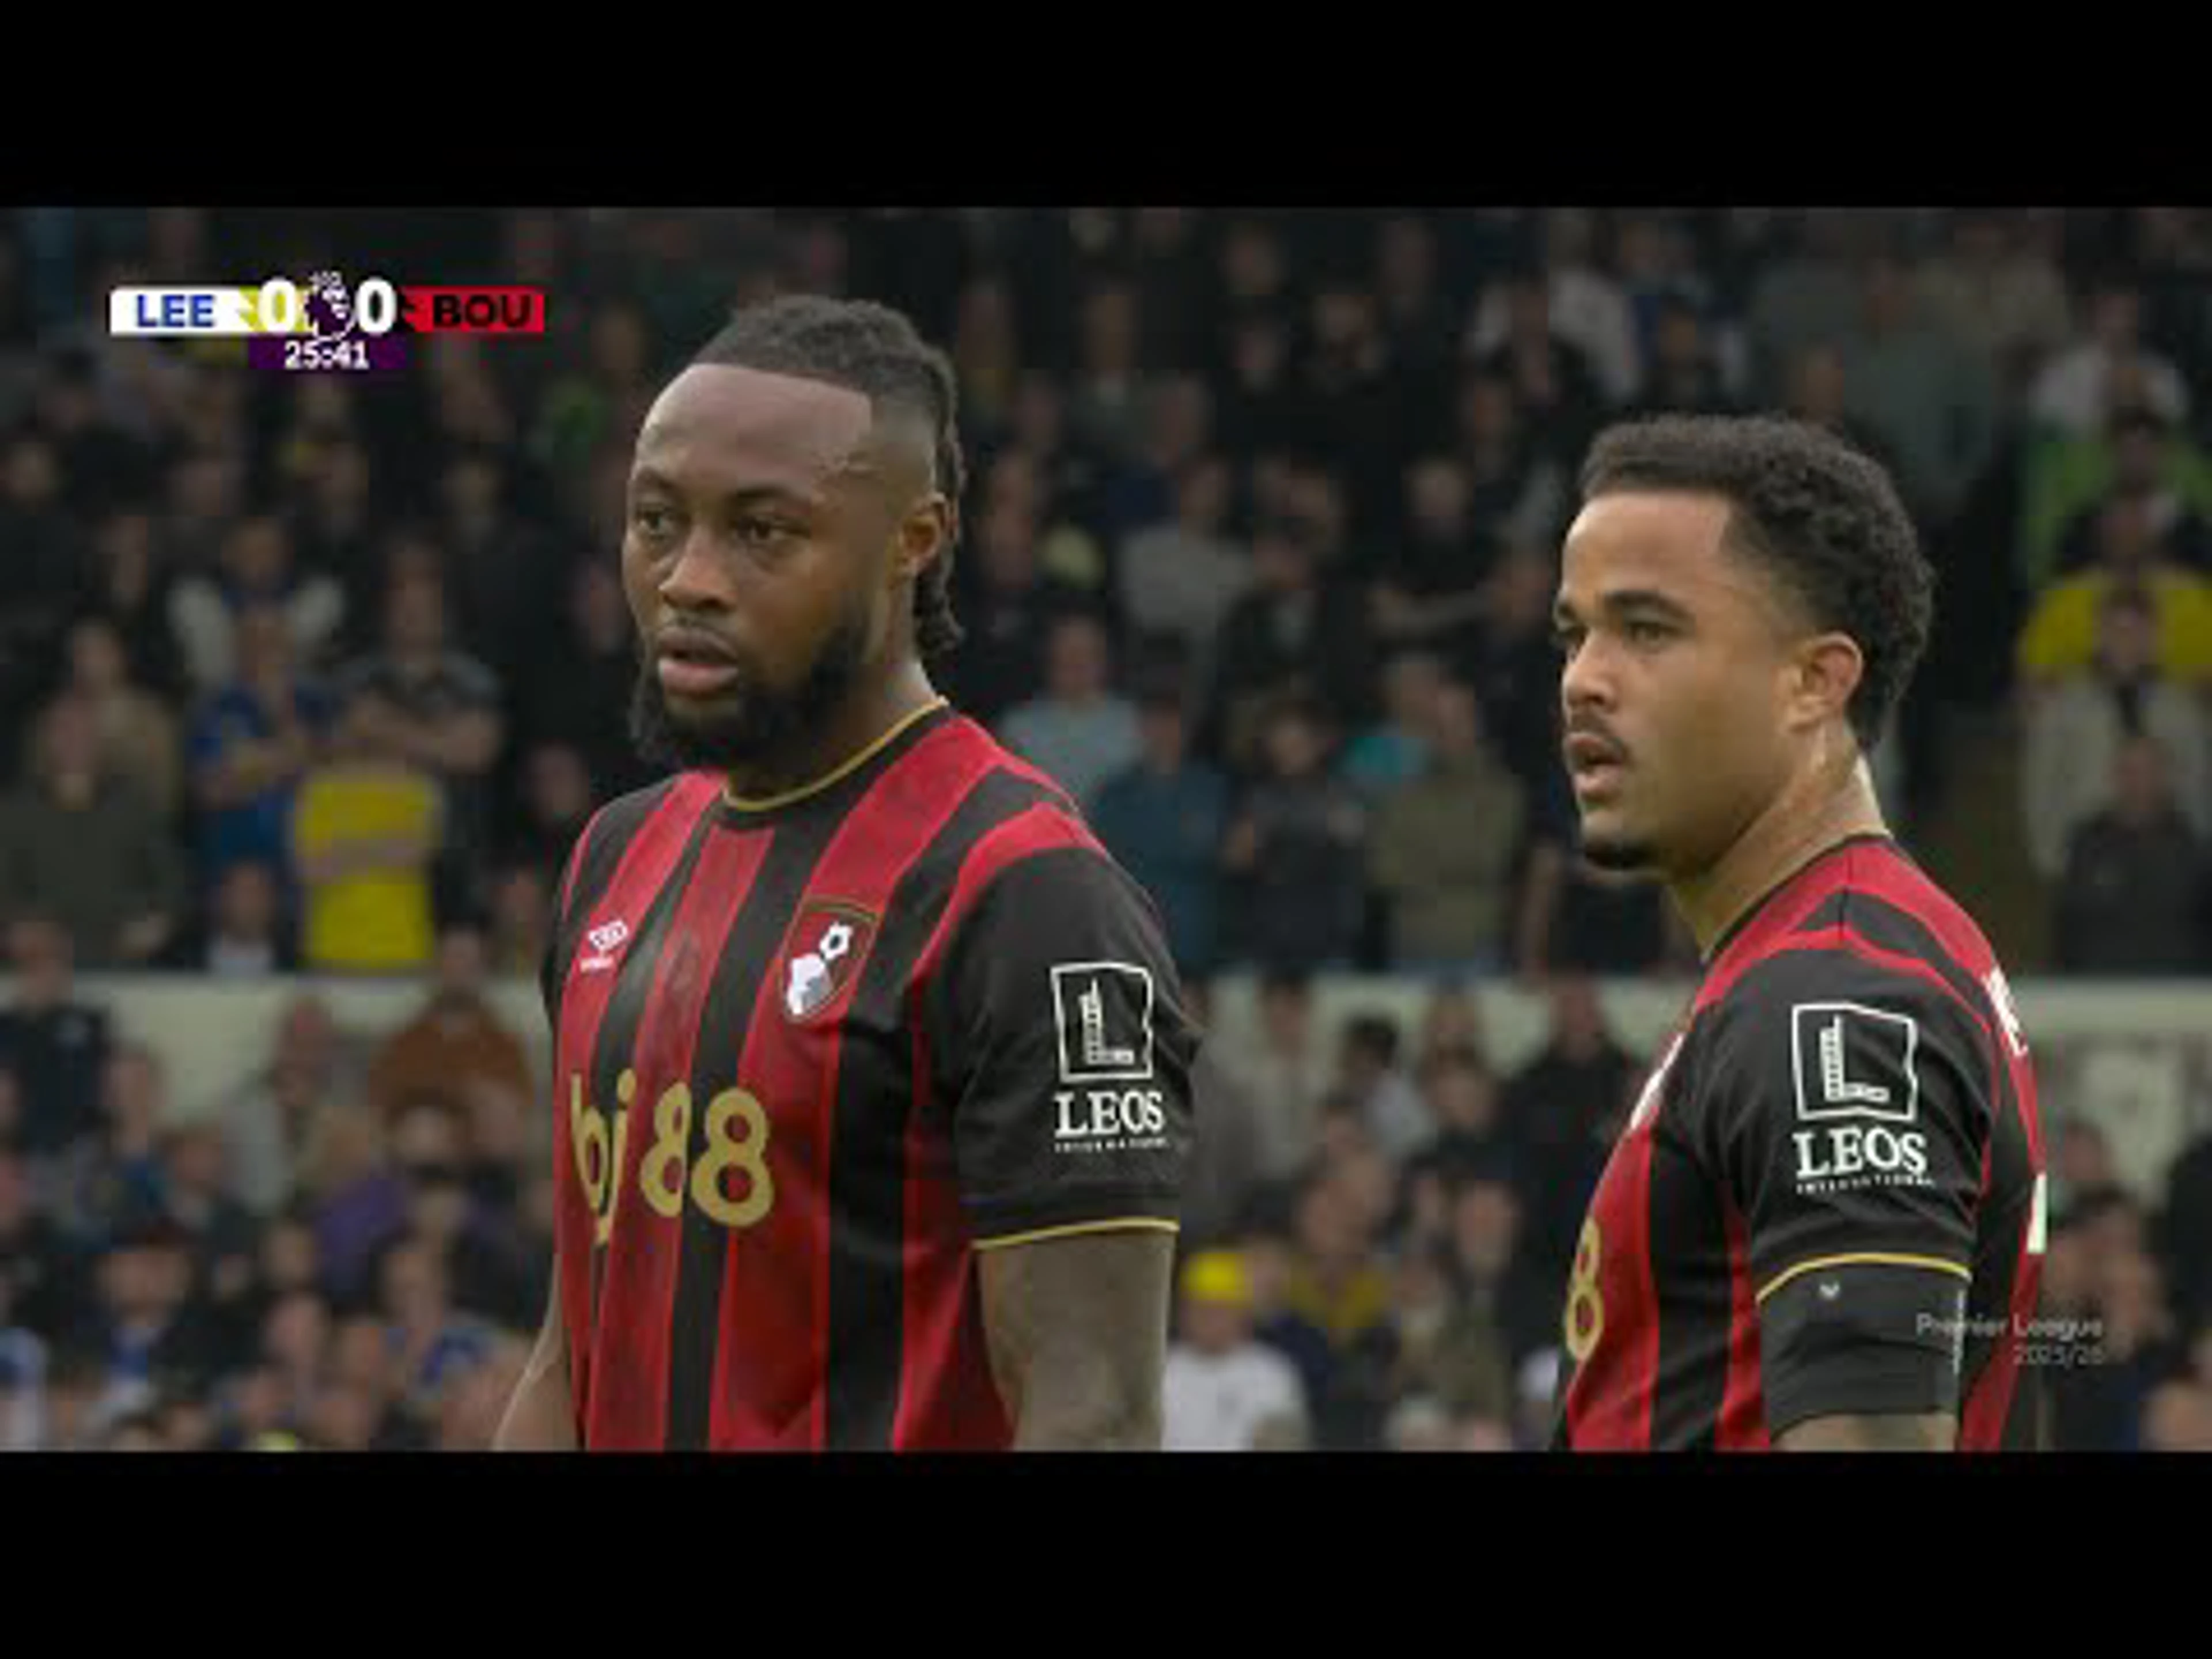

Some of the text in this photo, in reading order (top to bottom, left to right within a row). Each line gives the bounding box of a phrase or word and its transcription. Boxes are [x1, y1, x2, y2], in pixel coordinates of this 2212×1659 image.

[1054, 1090, 1164, 1138] LEOS
[571, 1068, 775, 1245] bj 88
[1791, 1125, 1927, 1180] LEOS
